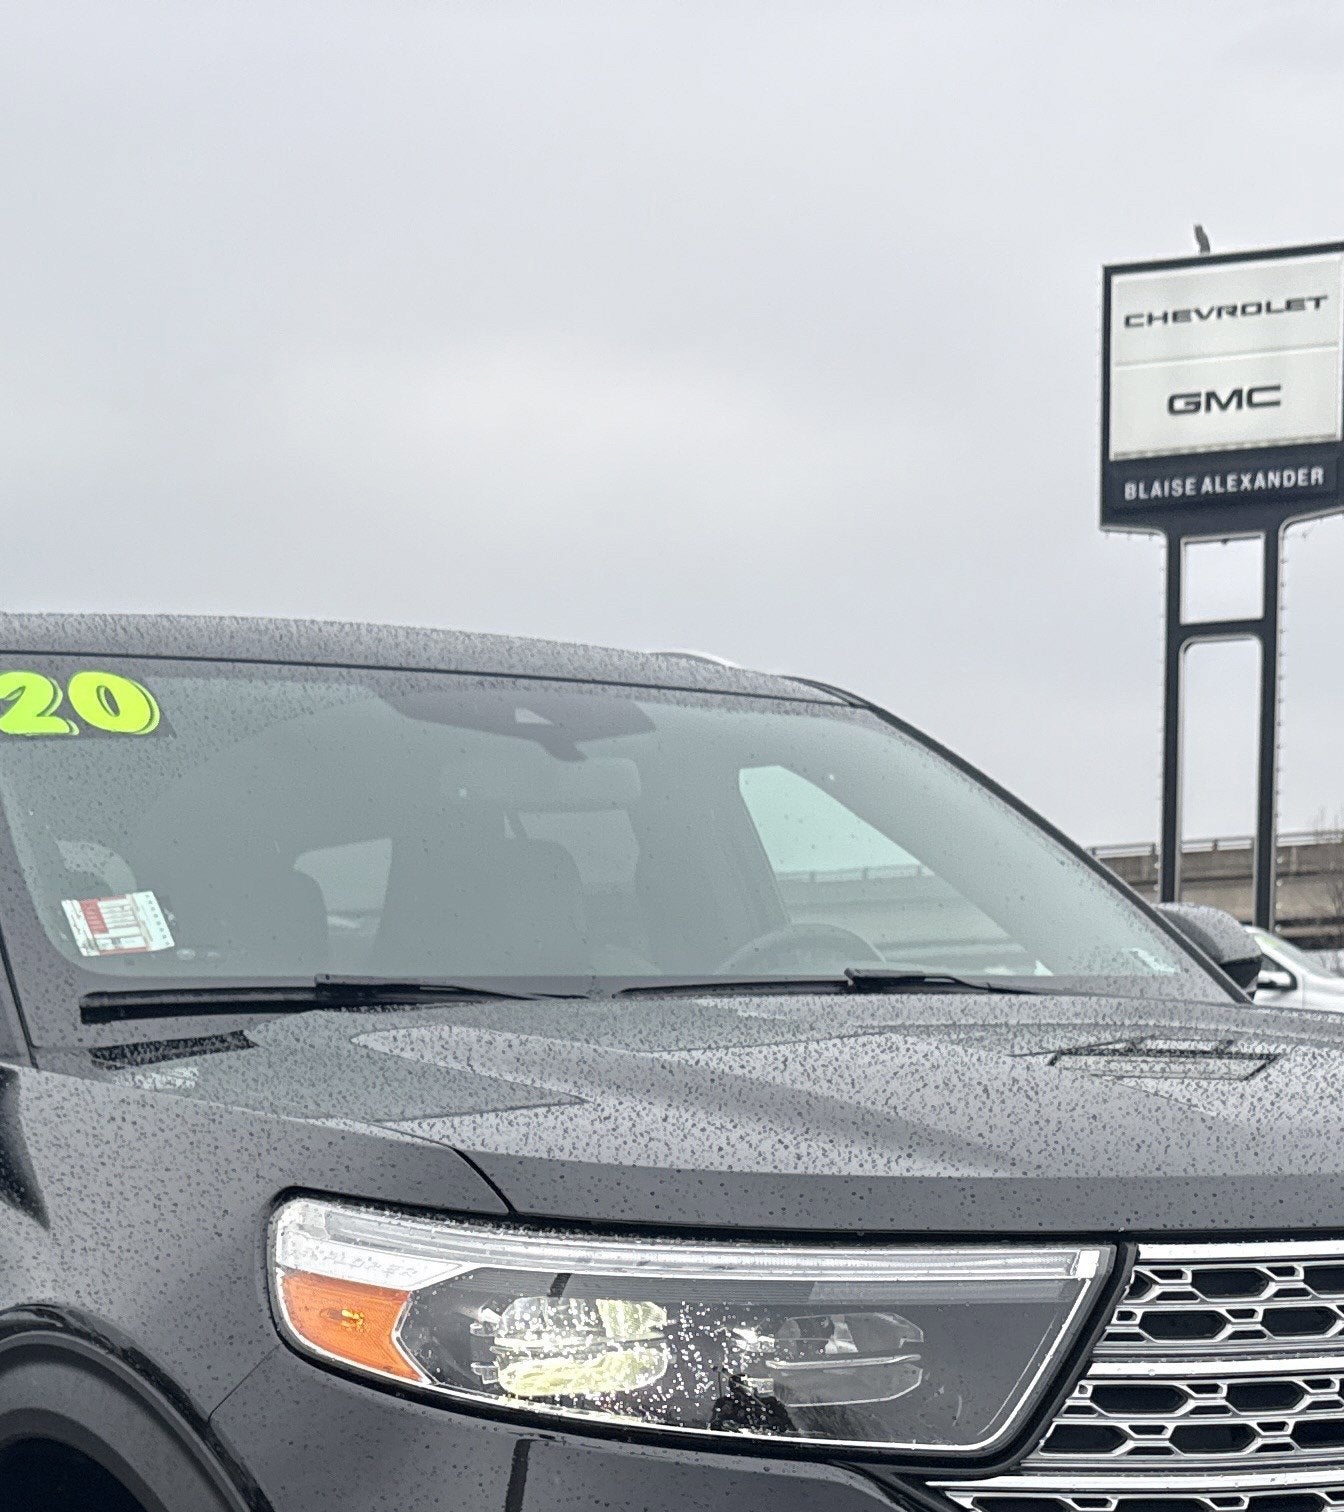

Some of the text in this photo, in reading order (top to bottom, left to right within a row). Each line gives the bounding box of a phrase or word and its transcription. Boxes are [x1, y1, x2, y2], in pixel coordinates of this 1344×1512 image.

[1123, 295, 1329, 329] CHEVROLET
[1167, 384, 1282, 416] GMC
[1124, 466, 1325, 501] BLAISE ALEXANDER
